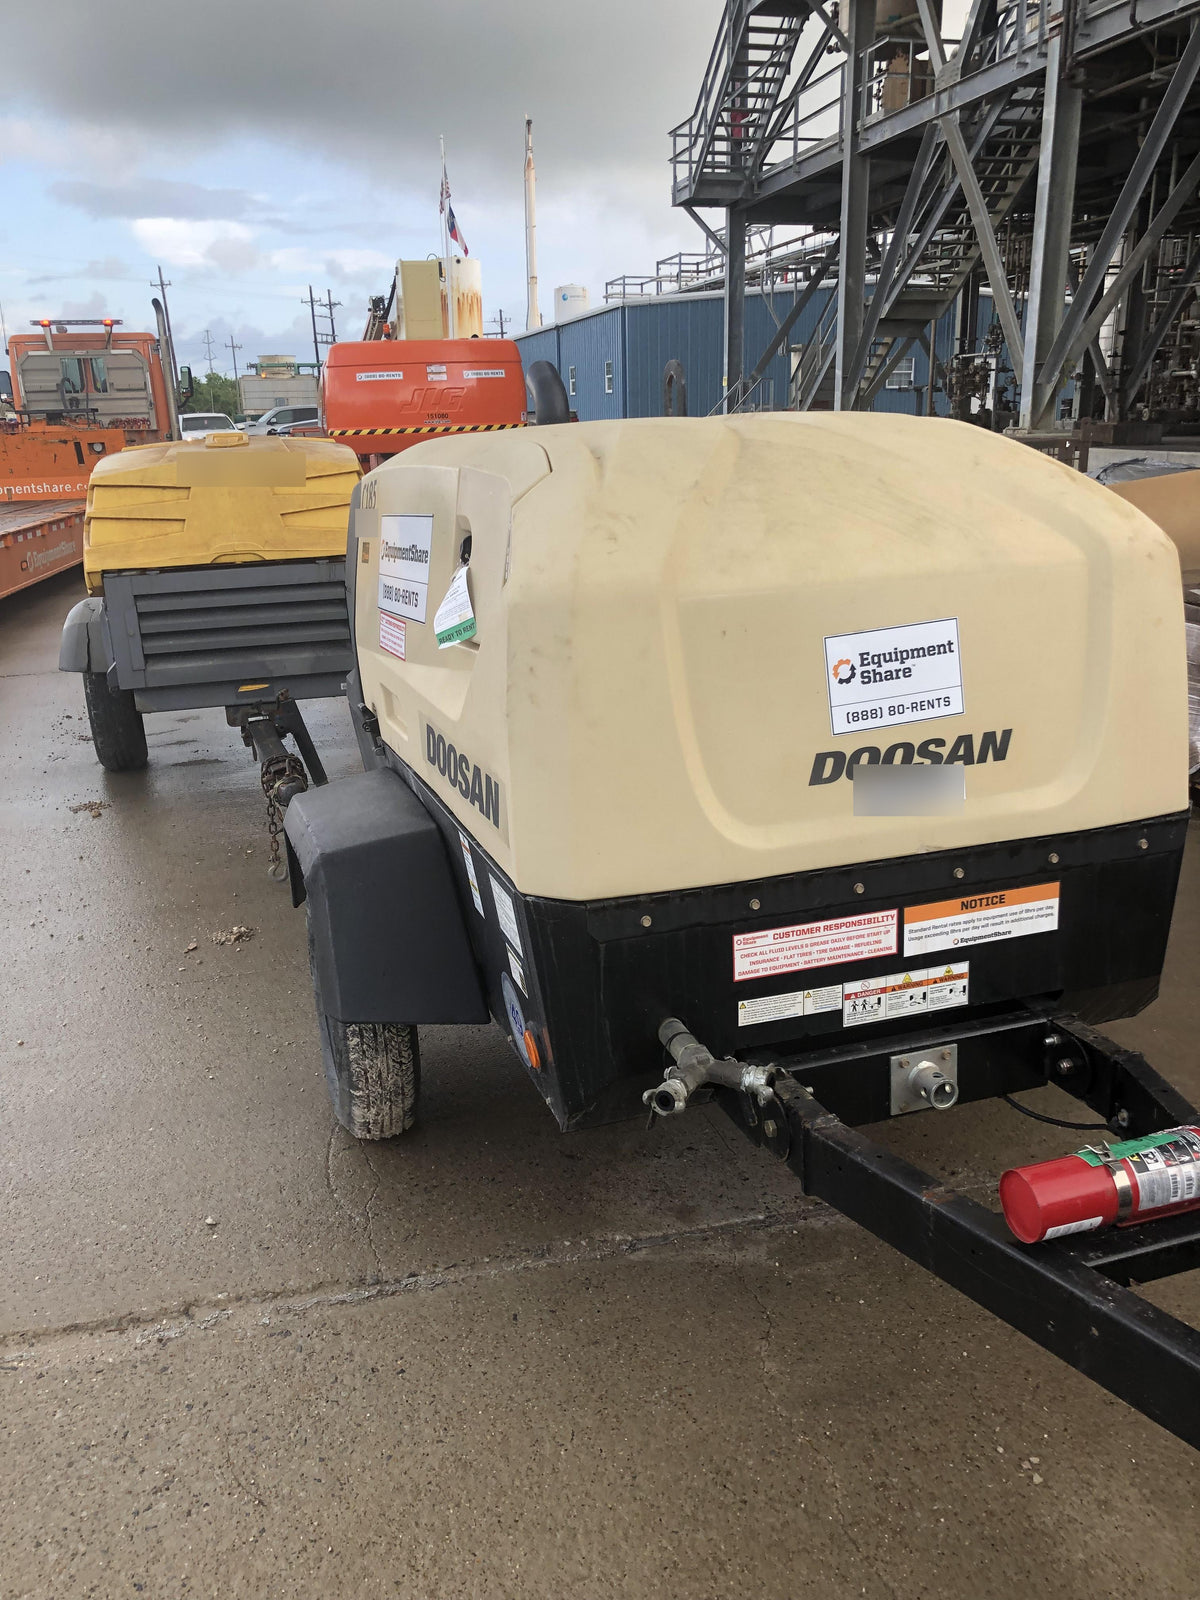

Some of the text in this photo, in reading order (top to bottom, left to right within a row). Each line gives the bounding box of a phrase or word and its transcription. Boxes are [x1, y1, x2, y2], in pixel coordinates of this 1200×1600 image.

[400, 387, 467, 413] JLG
[0, 482, 88, 495] mentshare.c
[385, 541, 429, 564] EquipmentShare
[394, 587, 419, 608] 80-RENTS
[438, 622, 476, 645] READY TO RENT
[859, 640, 954, 668] Equipment
[860, 666, 912, 685] Share
[846, 696, 951, 724] (888) 80-RENTS
[808, 728, 1012, 786] DOOSAN
[426, 723, 500, 829] DOOSAN
[961, 894, 1006, 911] NOTICE
[773, 914, 896, 940] CUSTOMER RESPONSIBILITY
[908, 924, 932, 934] Standard
[932, 922, 948, 931] Rental
[962, 918, 976, 926] apply
[983, 912, 1008, 922] equipment
[908, 934, 924, 942] Usage
[990, 920, 1004, 928] result
[1010, 915, 1034, 924] additional
[768, 947, 785, 956] FLUID
[786, 944, 804, 953] LEVELS
[810, 940, 830, 948] GREASE
[830, 936, 846, 945] DAILY
[846, 932, 865, 942] BEFORE
[865, 930, 882, 939] START
[960, 930, 1012, 944] EquipmentShare
[738, 968, 760, 976] DAMAGE
[769, 961, 800, 972] EQUIPMENT
[804, 956, 826, 966] BATTERY
[826, 950, 864, 962] MAINTENANCE
[868, 945, 893, 955] CLEANING
[750, 956, 780, 967] INSURANCE
[796, 950, 812, 958] TIRES
[828, 944, 850, 954] DAMAGE
[854, 939, 882, 948] REFUELING
[898, 982, 924, 991] WARNING
[940, 973, 965, 982] WARNING
[857, 988, 881, 998] DANGER
